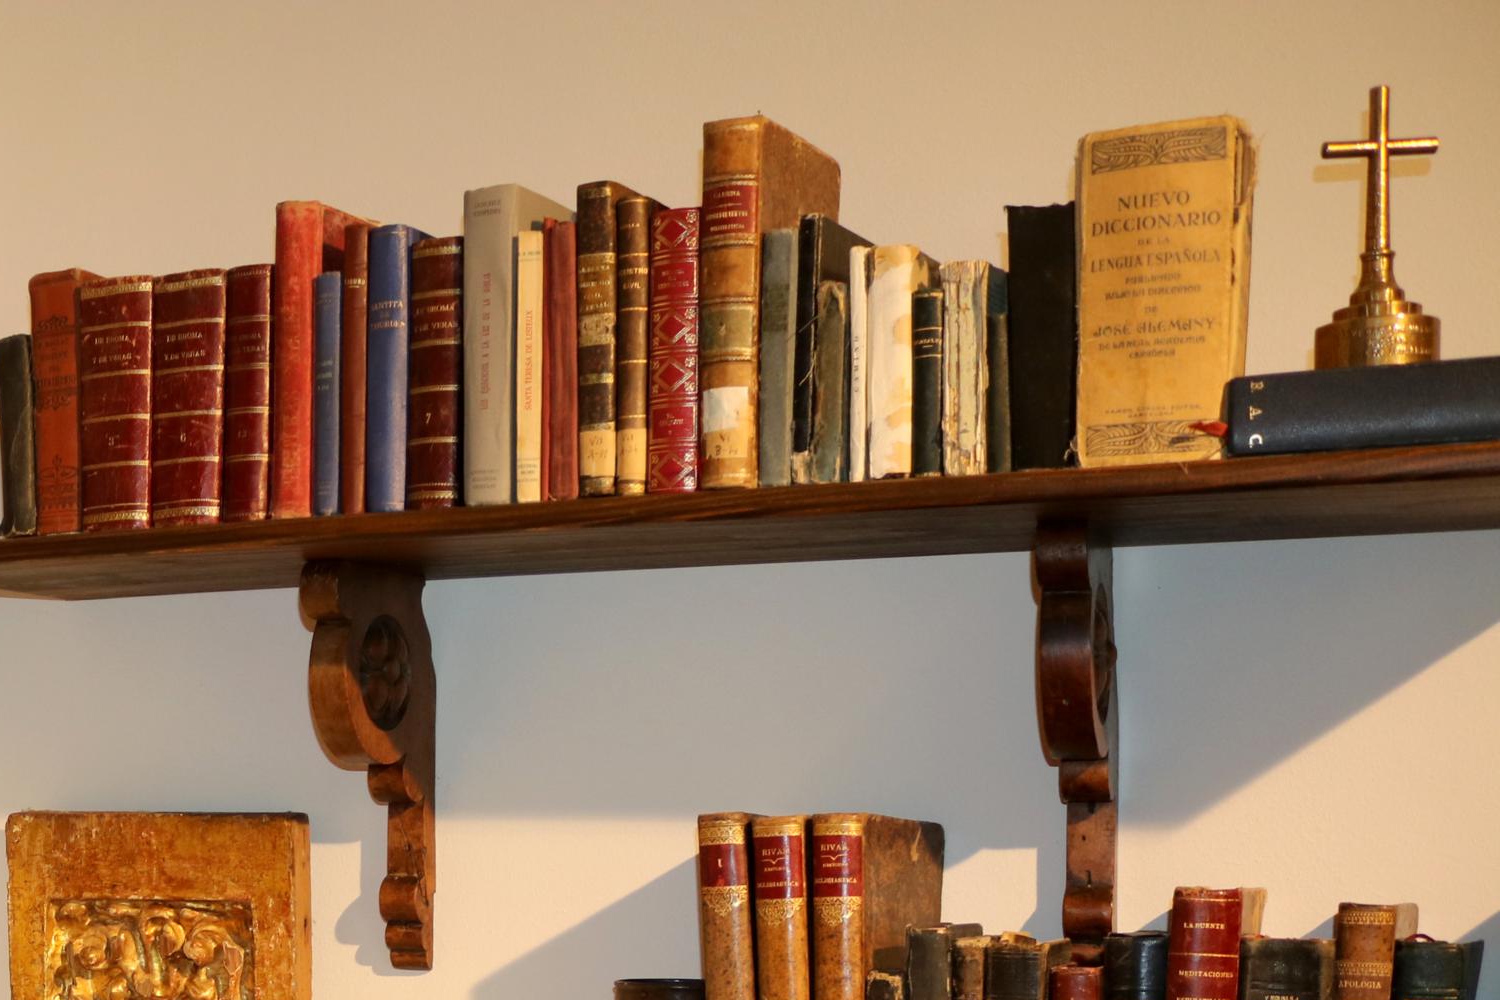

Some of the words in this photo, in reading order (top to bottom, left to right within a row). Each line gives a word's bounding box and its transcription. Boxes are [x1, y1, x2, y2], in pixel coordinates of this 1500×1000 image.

[1118, 190, 1190, 211] NUEVO
[1092, 210, 1221, 237] DICCIONARIO
[1090, 255, 1143, 273] LENGUA
[1147, 248, 1221, 265] ESPAÑOLA
[427, 302, 455, 313] BROMA
[524, 344, 532, 353] DE
[523, 357, 532, 384] TERESA
[523, 387, 532, 411] SANTA
[1178, 969, 1234, 979] MEDITACIONES
[1338, 980, 1382, 989] APOLOGIA
